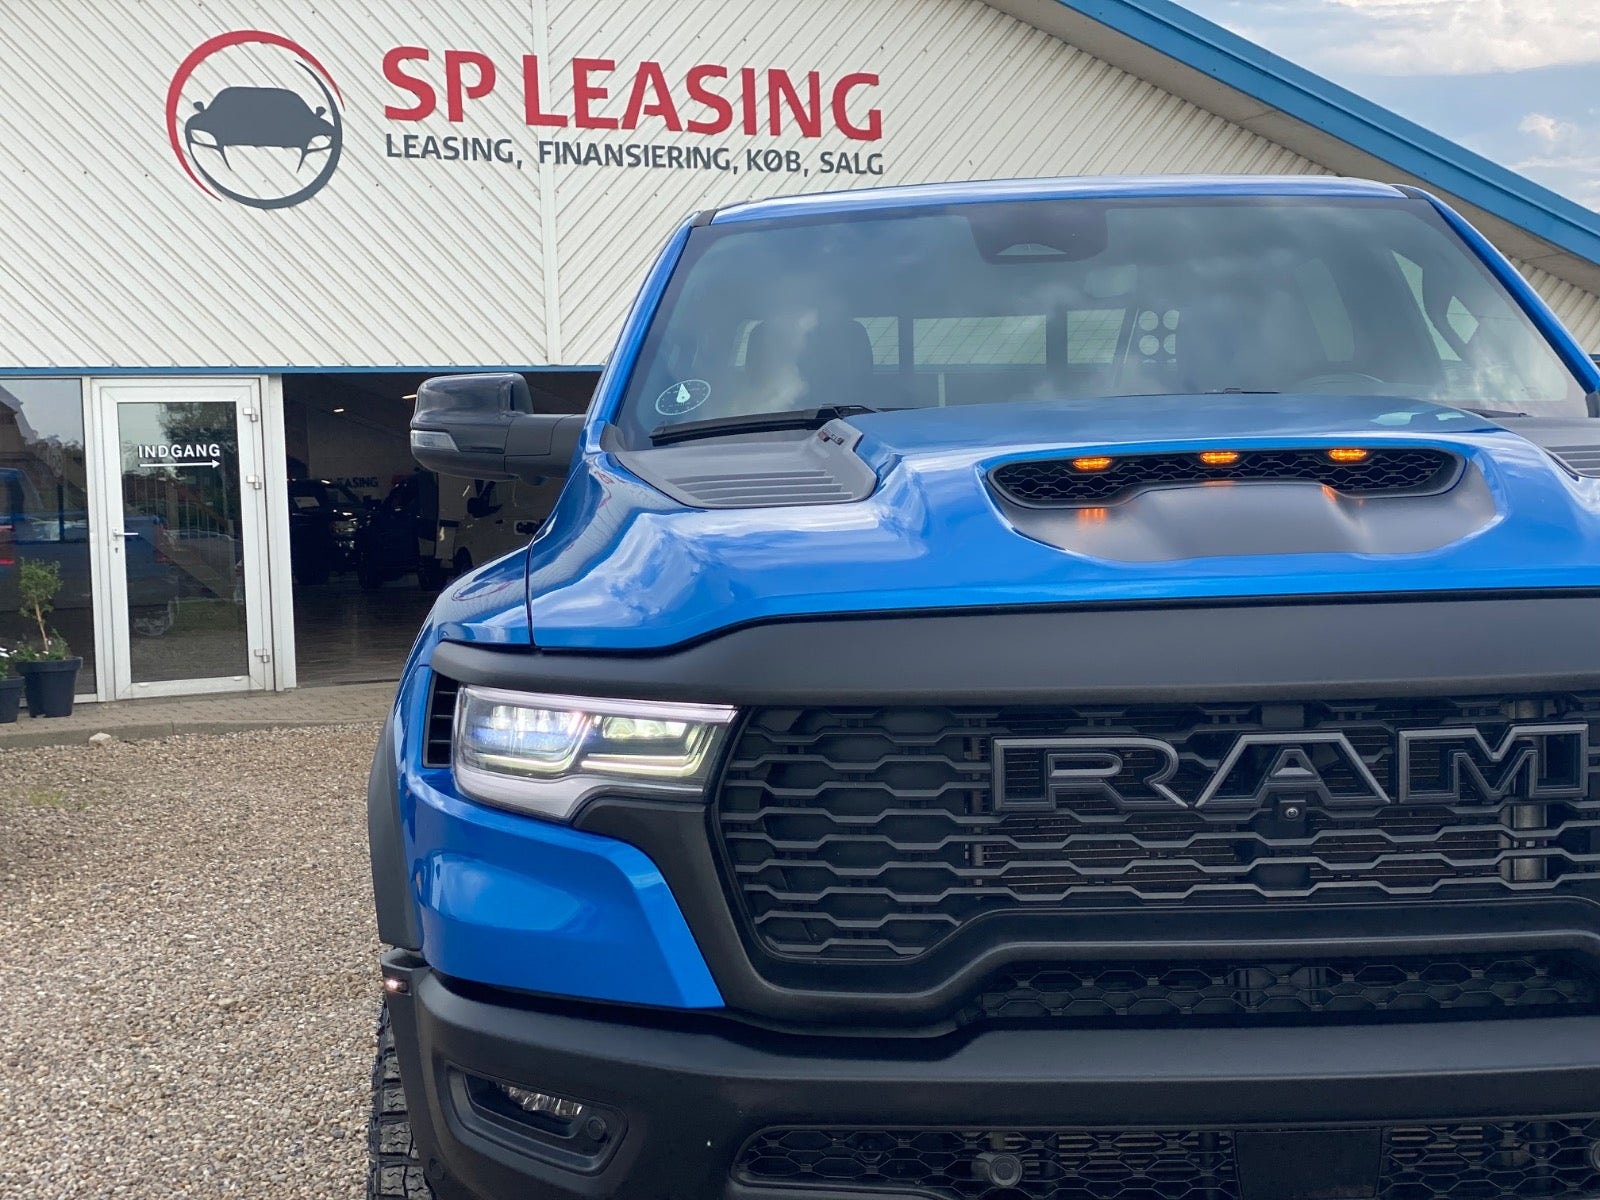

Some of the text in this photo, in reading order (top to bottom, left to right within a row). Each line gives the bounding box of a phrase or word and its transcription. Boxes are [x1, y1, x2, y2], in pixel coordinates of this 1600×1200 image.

[383, 46, 882, 141] SP LEASING
[386, 133, 884, 178] LEASING, FINANSIERING, KØB, SALG
[137, 443, 221, 459] INDGANG
[332, 476, 379, 488] EASING
[991, 722, 1589, 808] RAM
